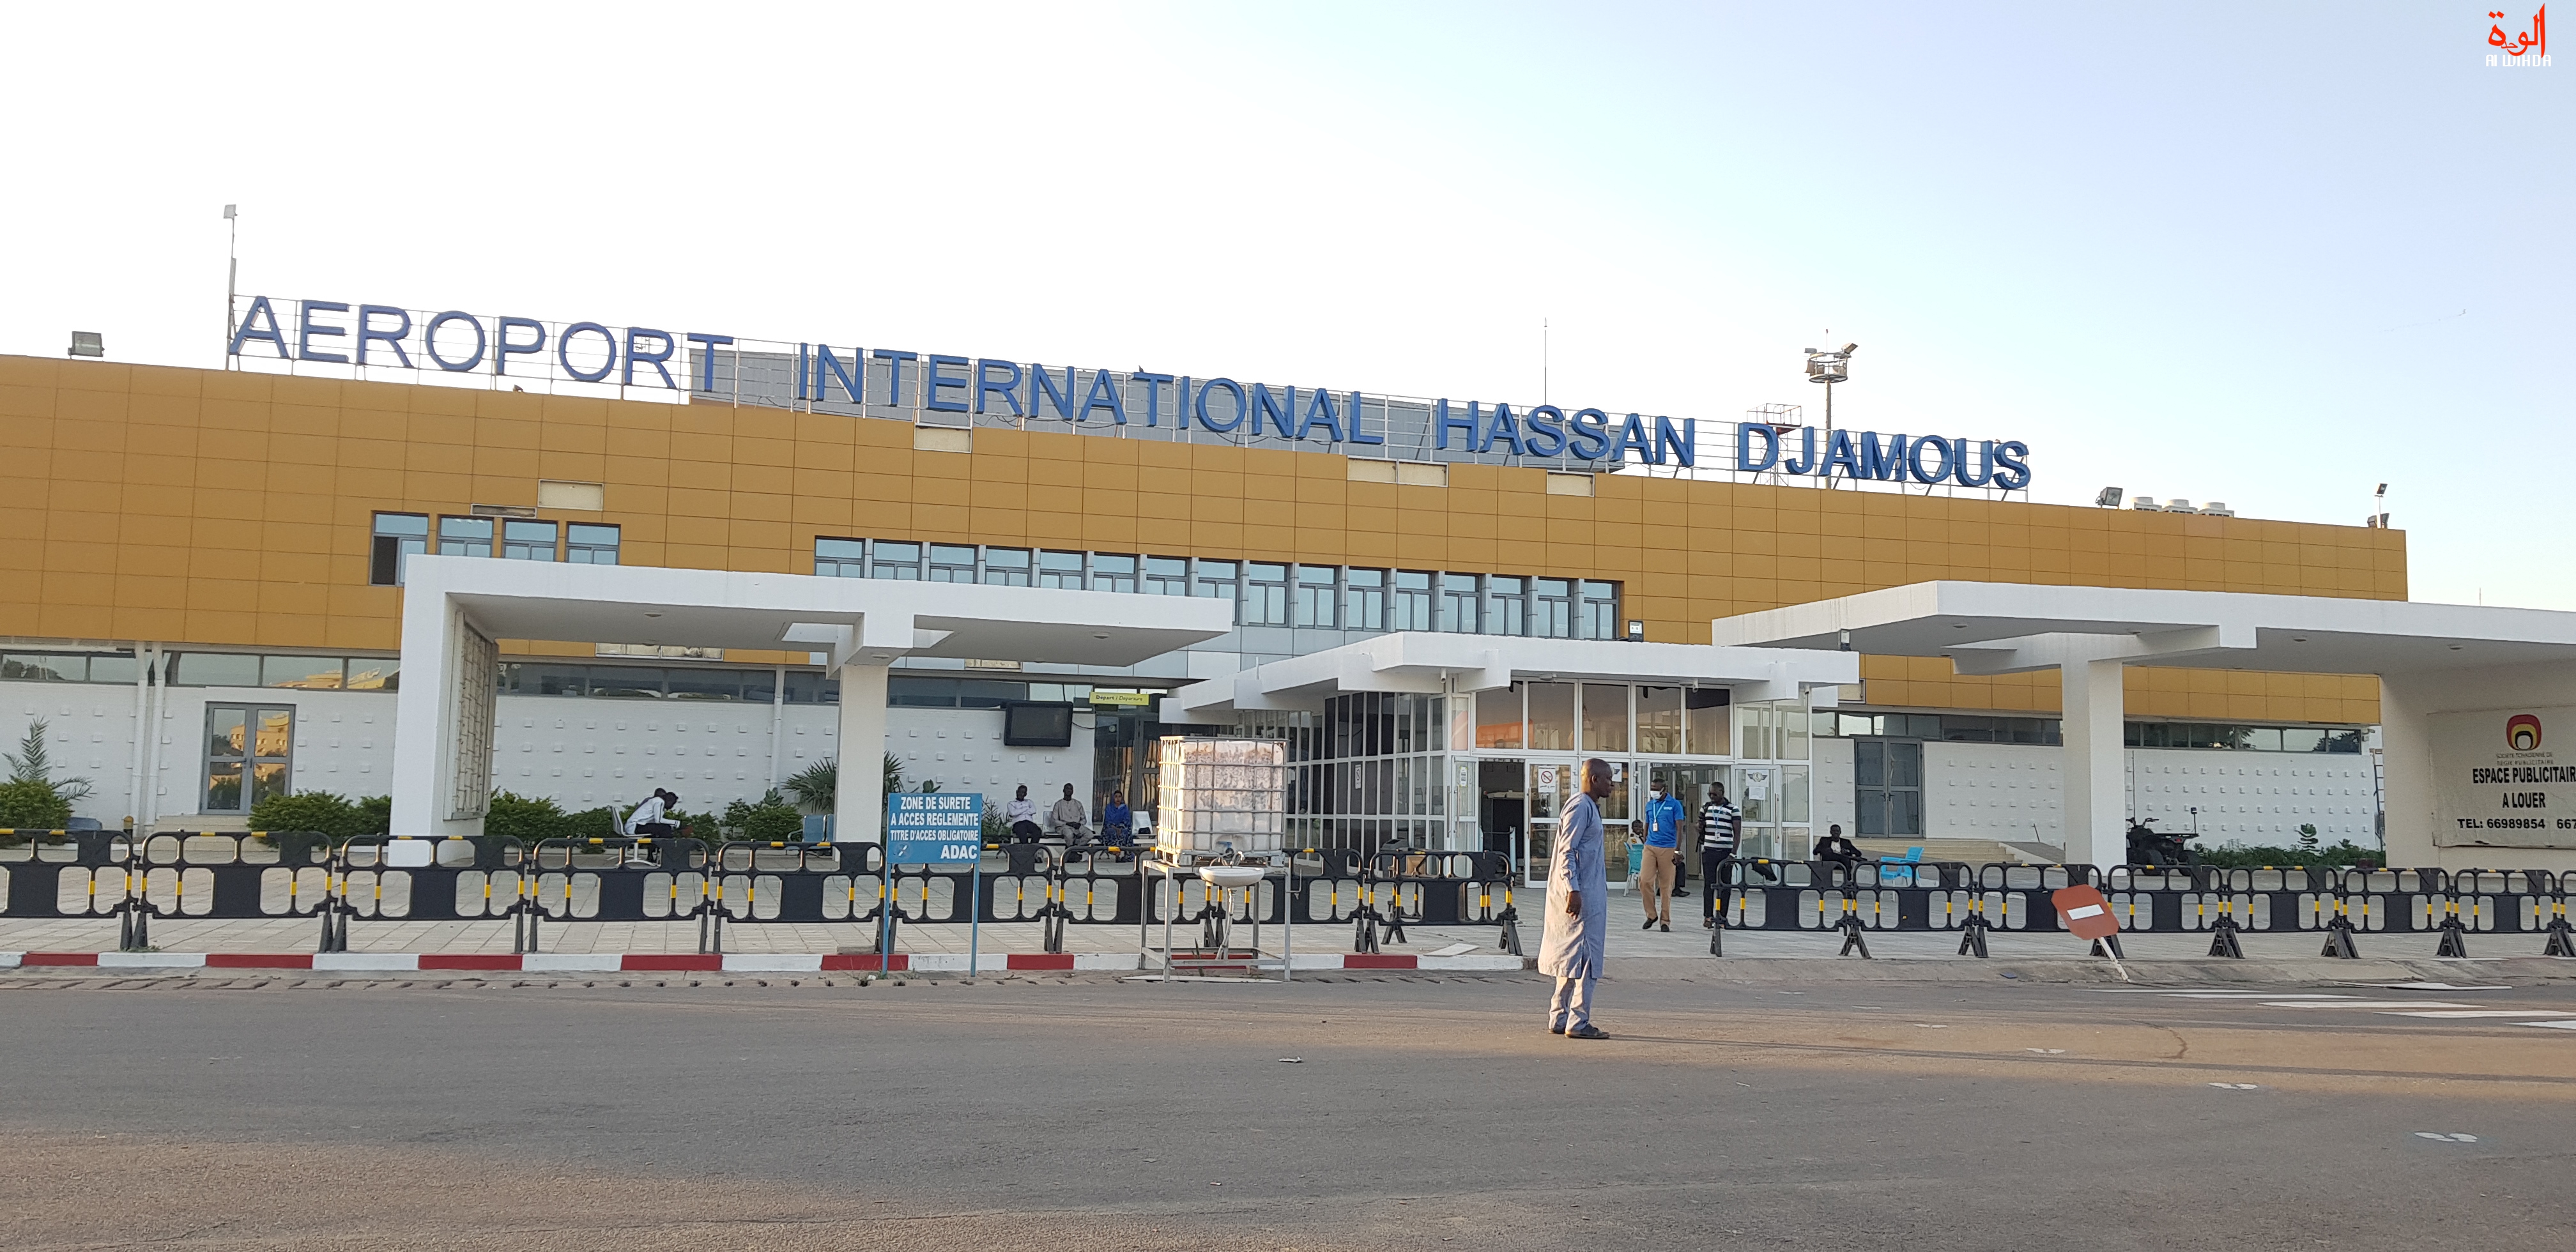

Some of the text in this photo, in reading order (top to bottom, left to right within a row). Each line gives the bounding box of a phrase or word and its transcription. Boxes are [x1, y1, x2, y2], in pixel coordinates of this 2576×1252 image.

[228, 295, 2031, 489] AEROPORT INTERNATIONAL HASSAN DJAMOUS
[2472, 767, 2510, 784] ESPACE
[900, 797, 971, 810] ZONE DE SURETE
[2502, 792, 2546, 809] A LOUER
[891, 813, 979, 826] A ACCES REGLEMENTE
[2457, 818, 2576, 829] TEL: 66989854 667
[890, 830, 979, 841] TITRE D'ACCES OBLIGATOIRE
[940, 844, 977, 860] ADAC
